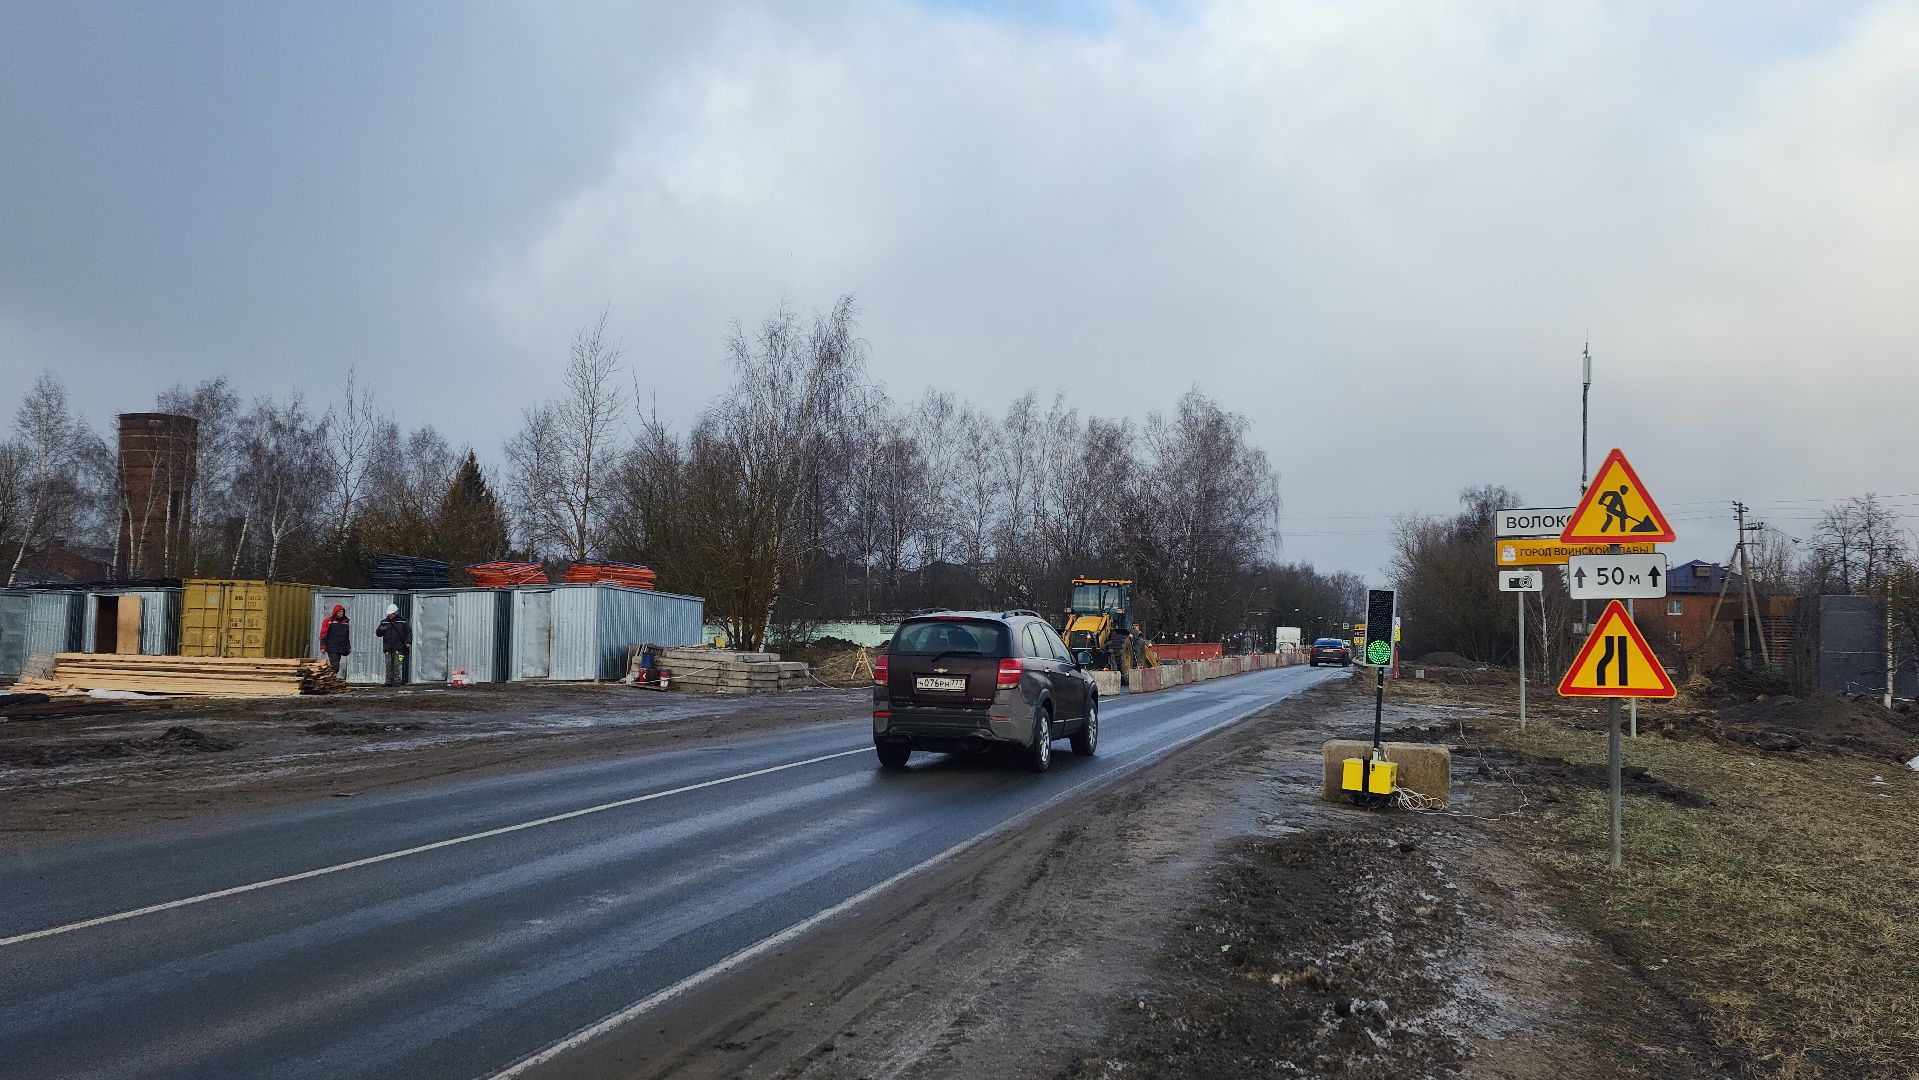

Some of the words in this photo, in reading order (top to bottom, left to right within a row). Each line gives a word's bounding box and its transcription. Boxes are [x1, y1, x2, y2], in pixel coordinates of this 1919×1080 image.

[1520, 548, 1552, 557] ГОРОД
[1619, 546, 1649, 554] ЛАВЫ
[1597, 567, 1625, 585] 50
